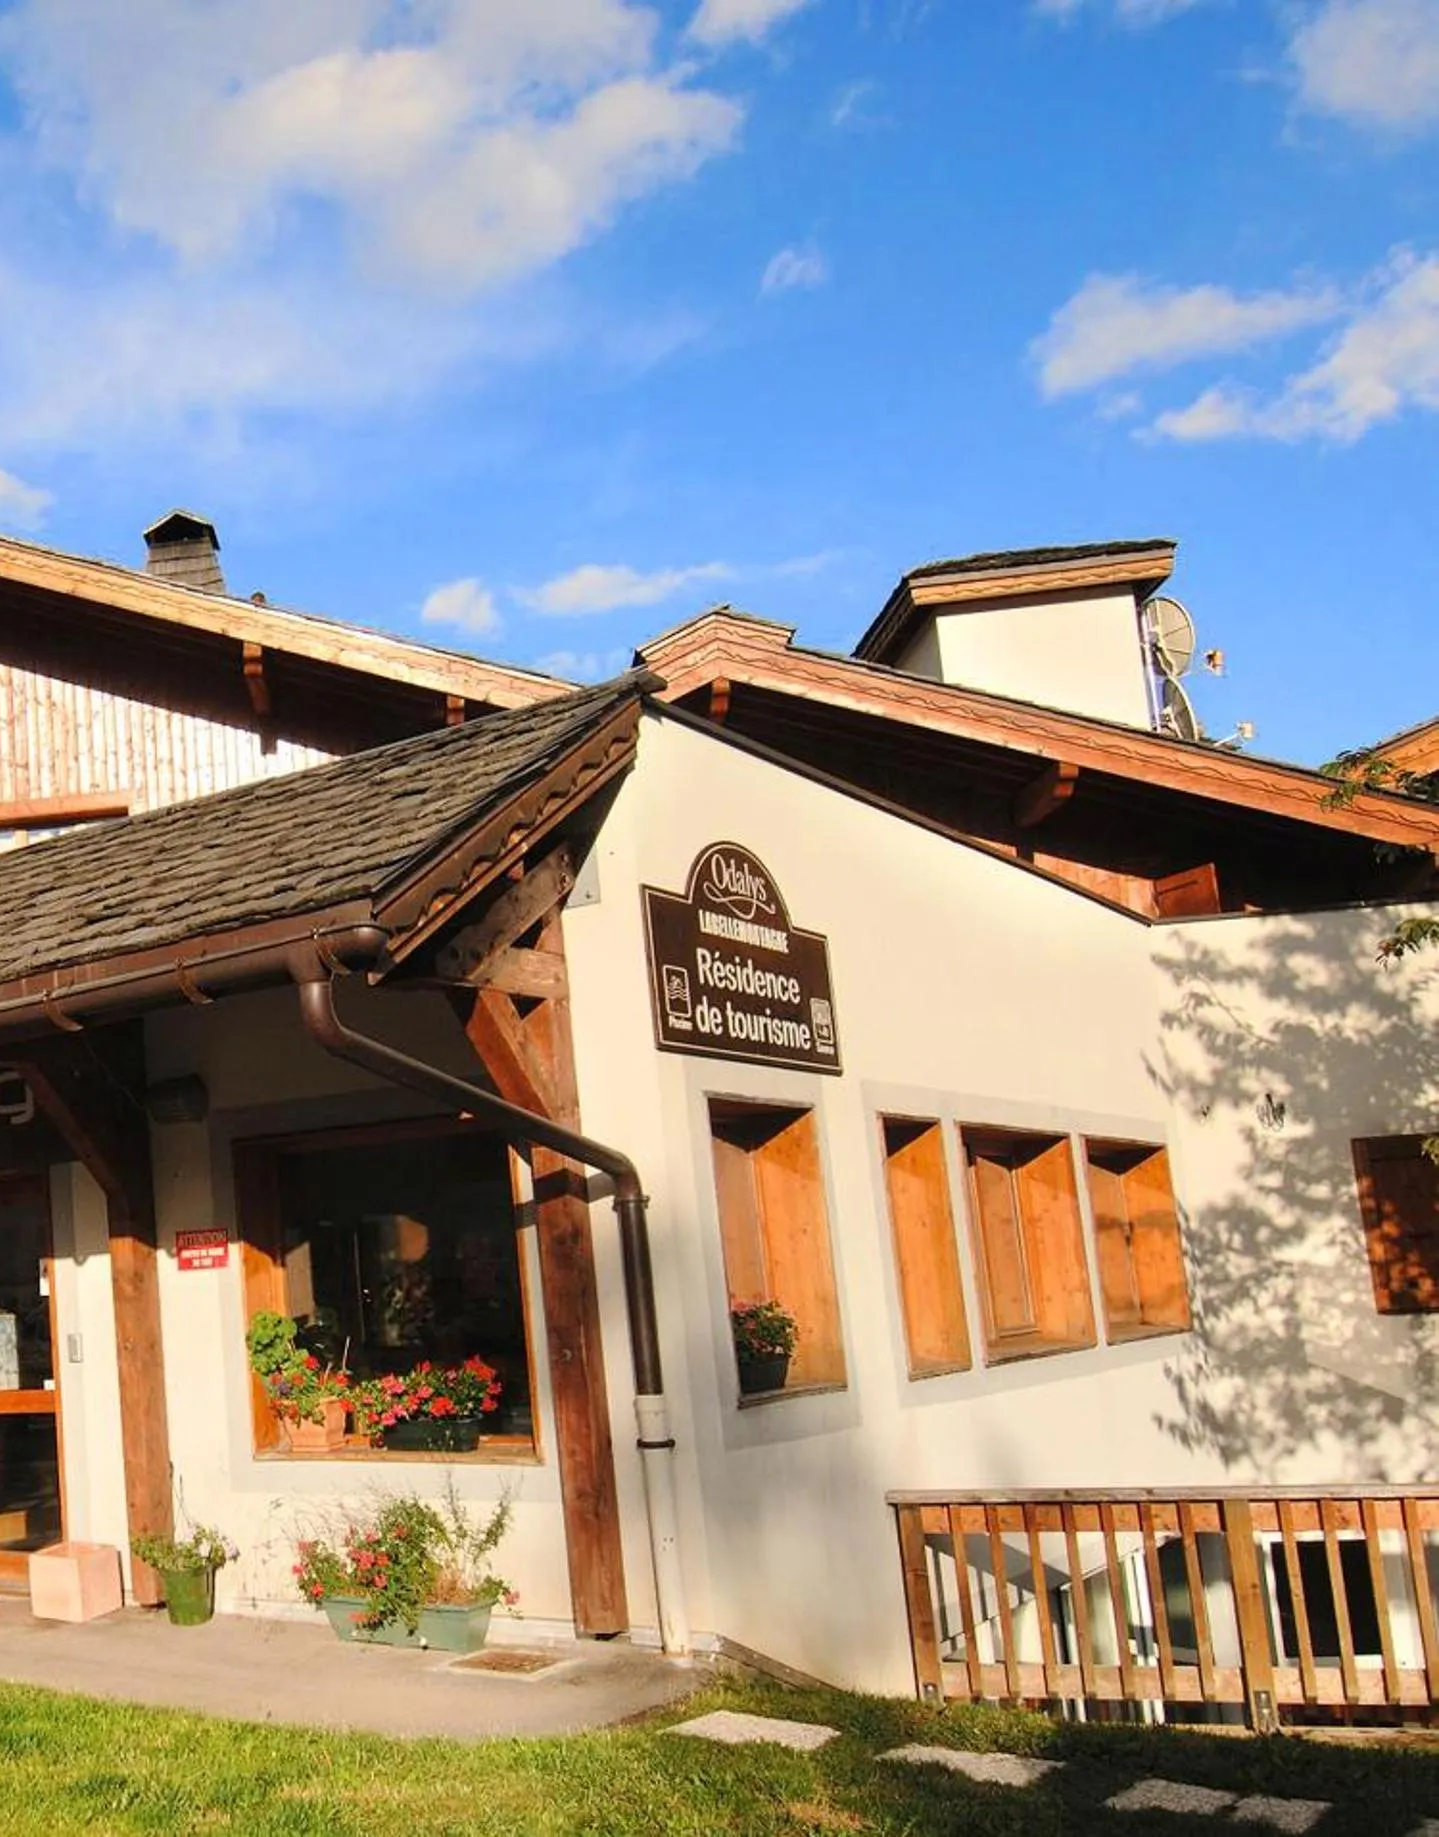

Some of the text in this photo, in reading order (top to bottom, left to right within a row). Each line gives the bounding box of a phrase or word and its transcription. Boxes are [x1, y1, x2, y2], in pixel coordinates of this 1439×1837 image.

[705, 853, 774, 915] Odalys
[696, 947, 801, 1004] Résidence
[695, 996, 812, 1050] de tourisme
